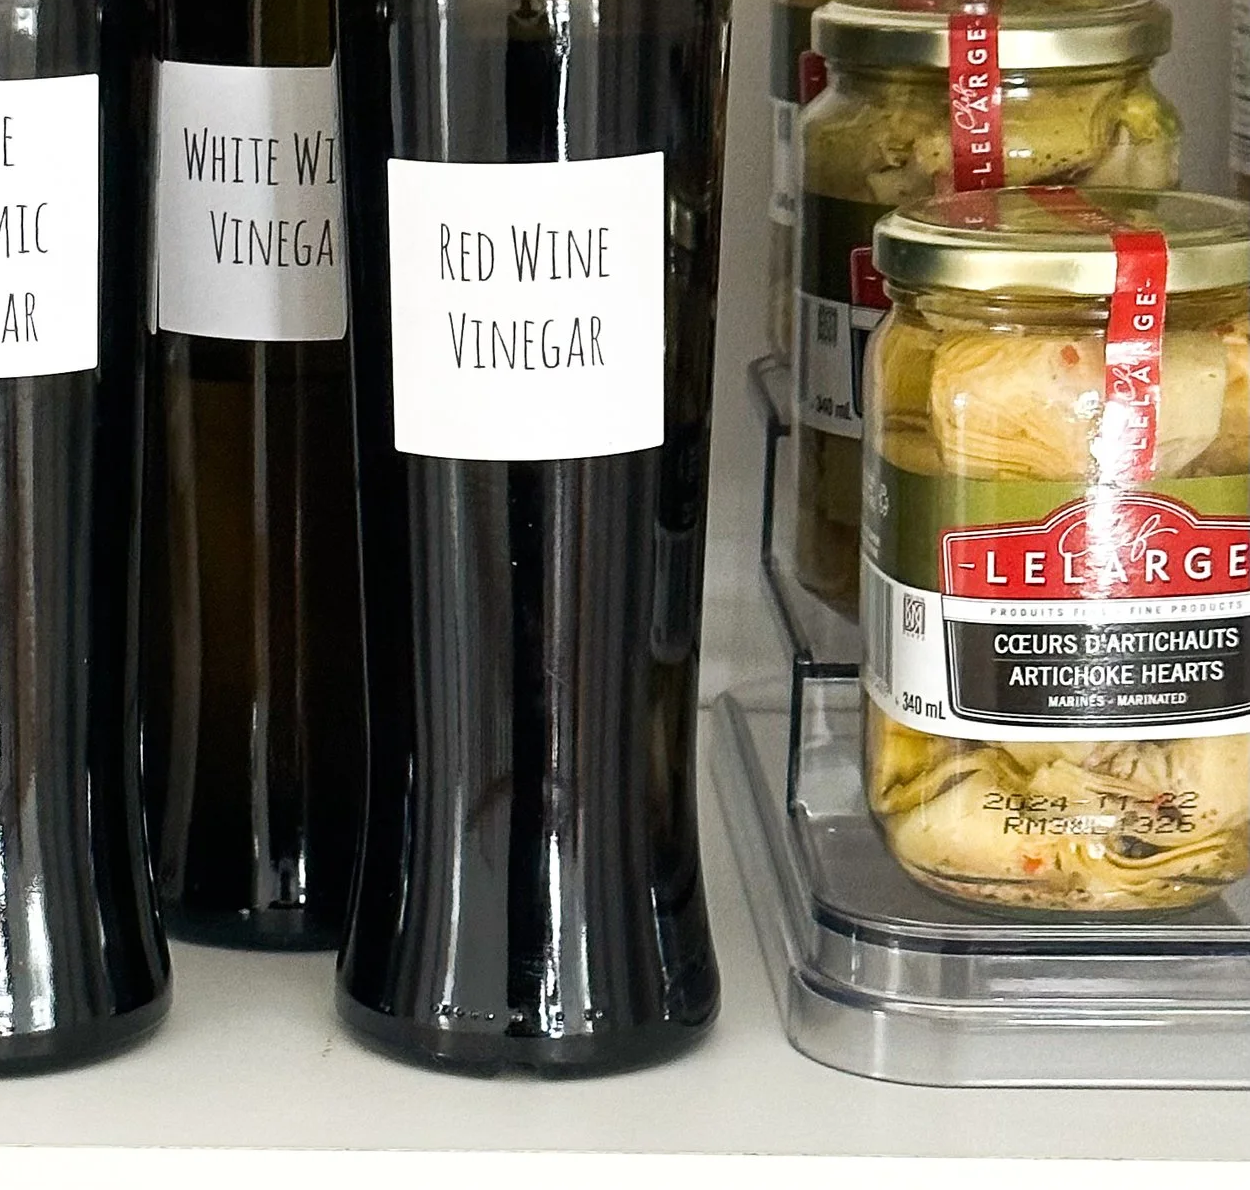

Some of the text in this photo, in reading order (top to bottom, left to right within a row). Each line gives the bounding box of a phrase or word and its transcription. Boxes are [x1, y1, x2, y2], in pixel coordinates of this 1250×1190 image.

[967, 28, 993, 174] LELARGE
[184, 127, 279, 186] WHITE
[440, 222, 611, 282] RED WINE
[448, 312, 605, 370] VINEGAR
[986, 543, 1249, 585] LELARGE
[990, 607, 1065, 618] PRODUITS
[1130, 605, 1162, 616] FINE
[1171, 600, 1243, 615] PRODUCTS
[994, 627, 1239, 656] CŒURS D'ARTICHAUTS
[1009, 660, 1224, 687] ARTICHOKE HEARTS
[902, 691, 946, 721] 340 mL
[1116, 692, 1188, 707] MARINATED
